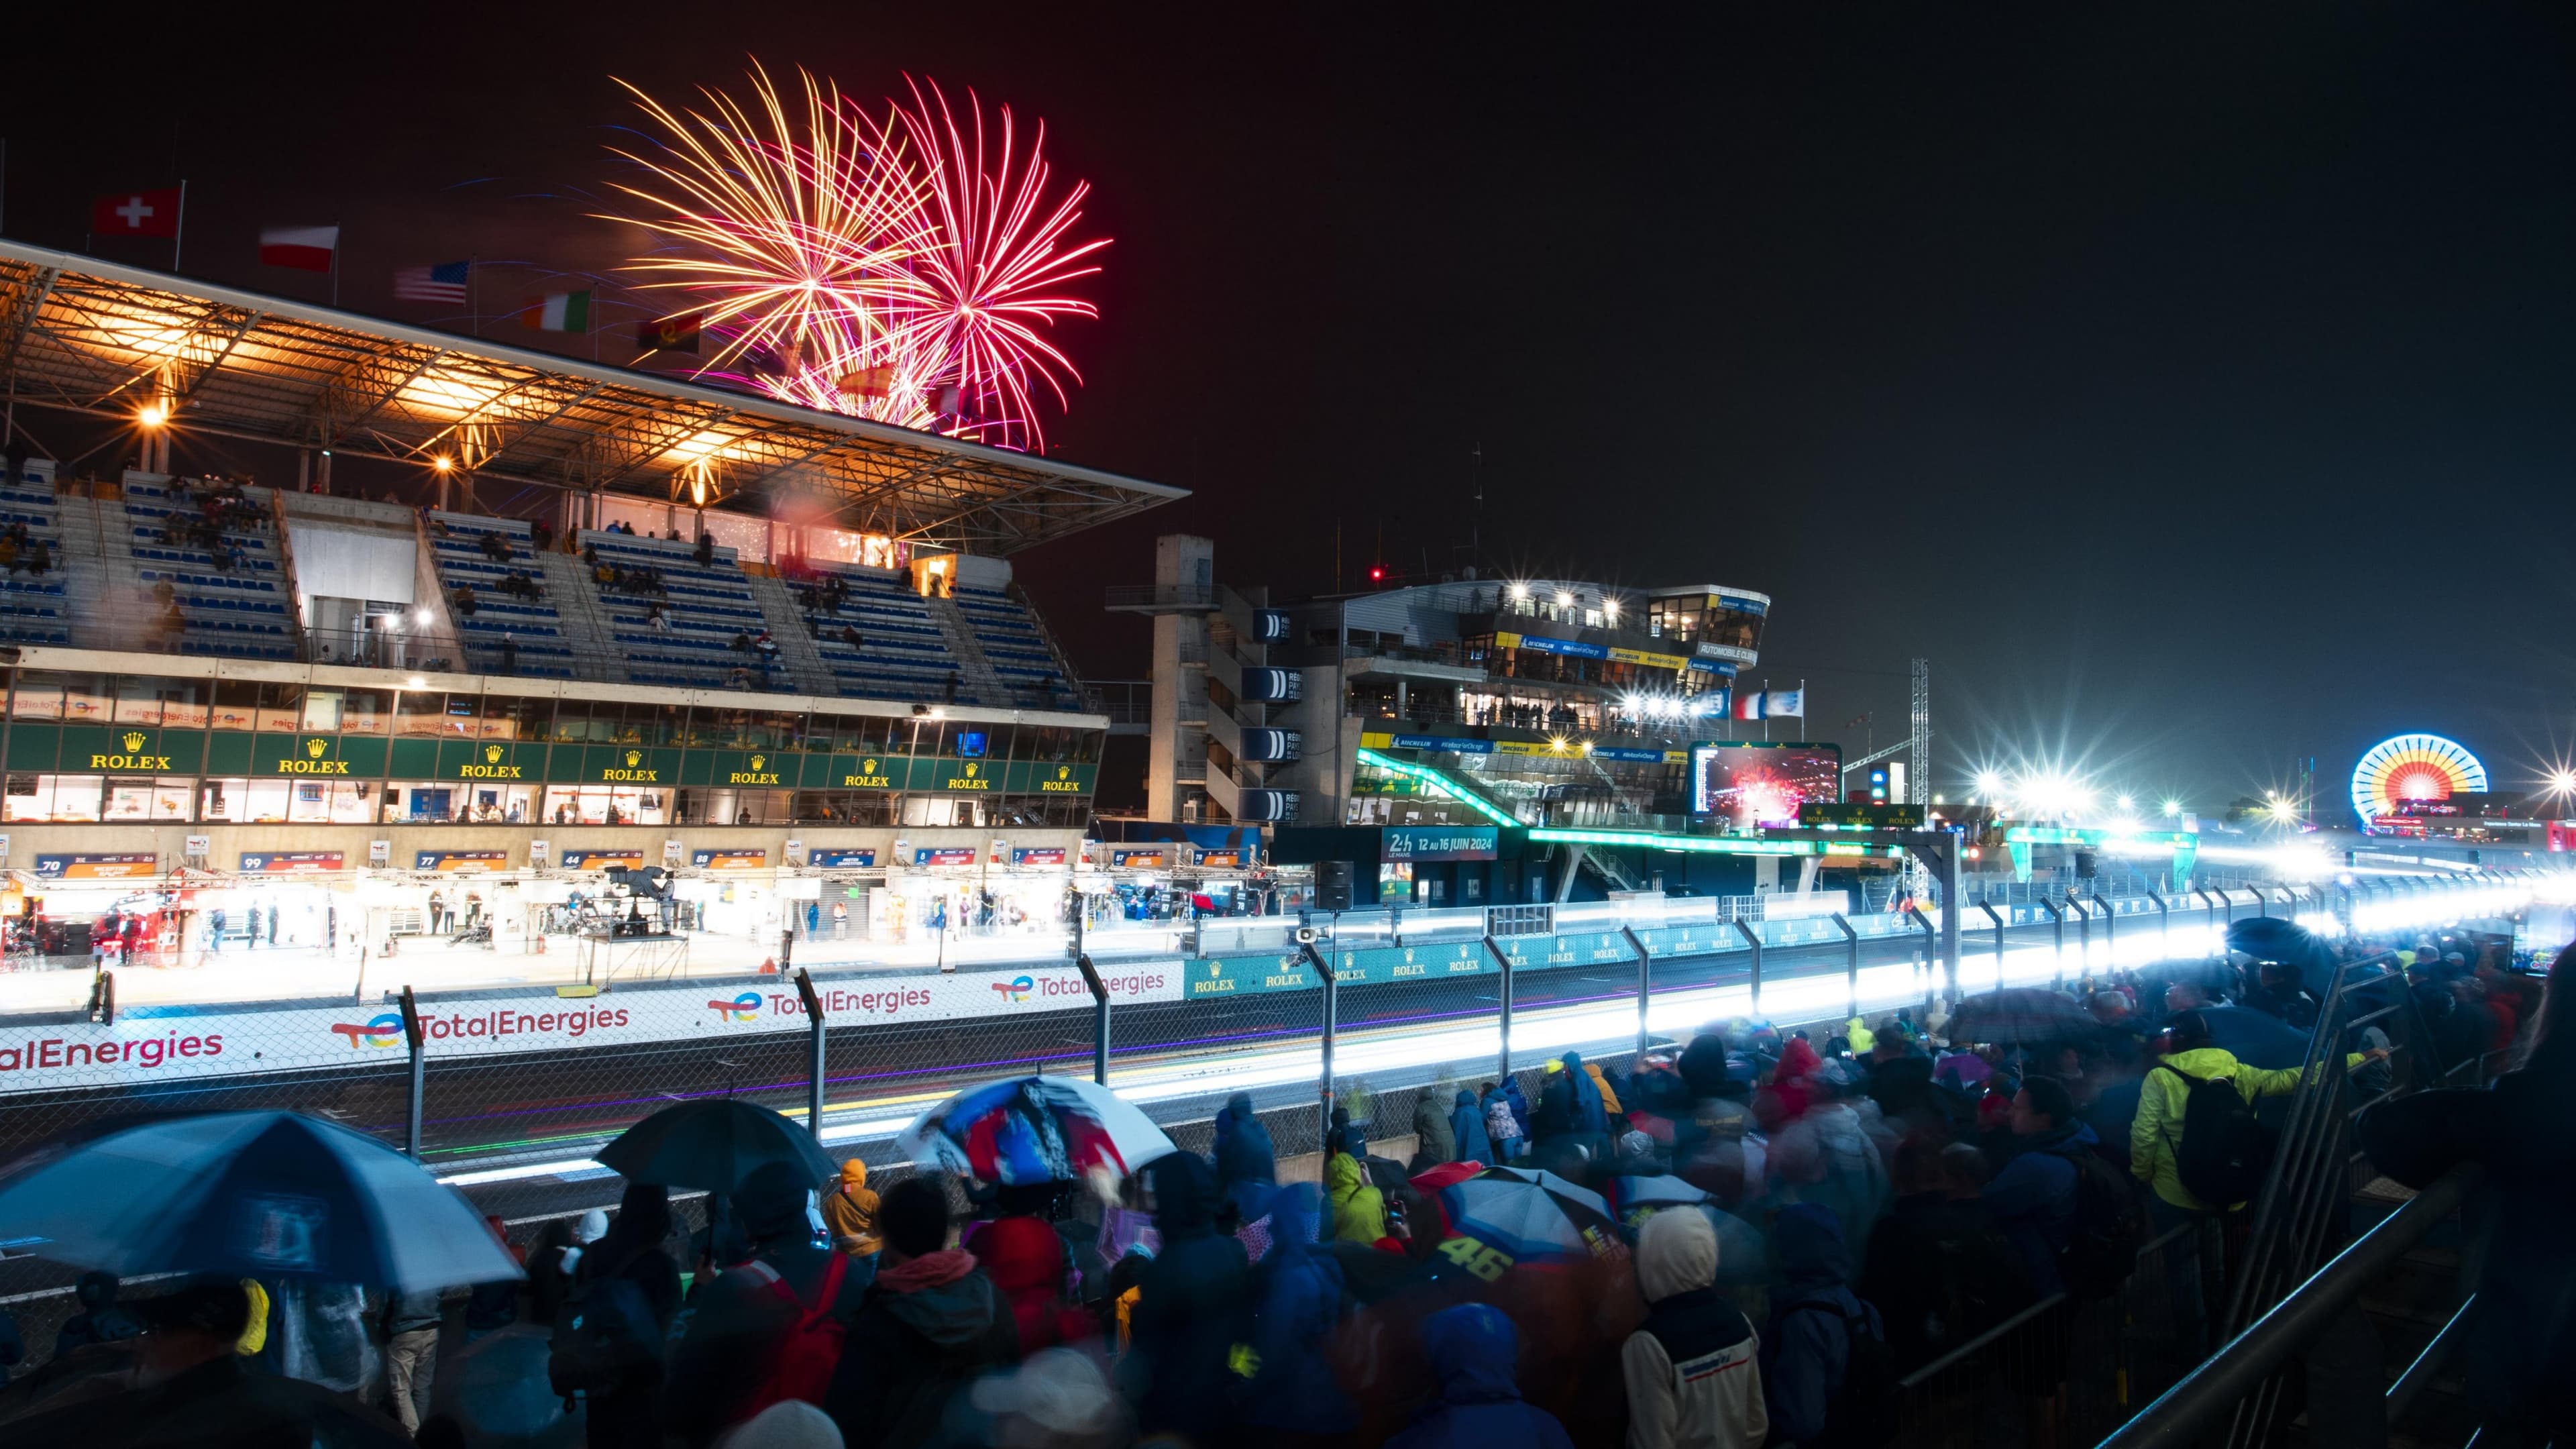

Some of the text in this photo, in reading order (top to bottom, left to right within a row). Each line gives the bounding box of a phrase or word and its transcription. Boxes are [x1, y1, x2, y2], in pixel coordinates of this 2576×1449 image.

[1527, 641, 1555, 649] MICHELIN
[1701, 645, 1741, 659] AUTOMOBILE
[91, 755, 171, 769] ROLEX
[277, 760, 349, 774] ROLEX
[460, 765, 521, 778] ROLEX
[602, 769, 657, 782] ROLEX
[729, 773, 779, 784] ROLEX
[844, 775, 889, 787] ROLEX
[948, 779, 988, 790] ROLEX
[1042, 781, 1079, 792] ROLEX
[1418, 837, 1492, 852] 12 AU 16 JUIN 2024
[421, 857, 435, 865] 77
[566, 856, 580, 864] 44
[696, 855, 709, 863] 88
[815, 853, 822, 861] 9
[920, 852, 926, 860] 8
[1015, 852, 1020, 860] 7
[42, 861, 61, 871] 70
[245, 858, 262, 869] 99
[1162, 904, 1170, 912] 87
[1238, 902, 1245, 910] 78
[1675, 942, 1697, 951] ROLEX
[1548, 953, 1574, 964] ROLEX
[1593, 949, 1618, 959] ROLEX
[1448, 959, 1479, 971] ROLEX
[1508, 955, 1528, 966] LEX
[1334, 969, 1366, 981] ROLEX
[1393, 964, 1426, 977] ROLEX
[1038, 971, 1165, 996] Totalnergies
[1195, 979, 1235, 993] ROLEX
[1265, 974, 1303, 987] ROLEX
[417, 1004, 629, 1040] TotalEnergies
[0, 1030, 223, 1071] alEnergies
[1438, 1236, 1514, 1283] 46
